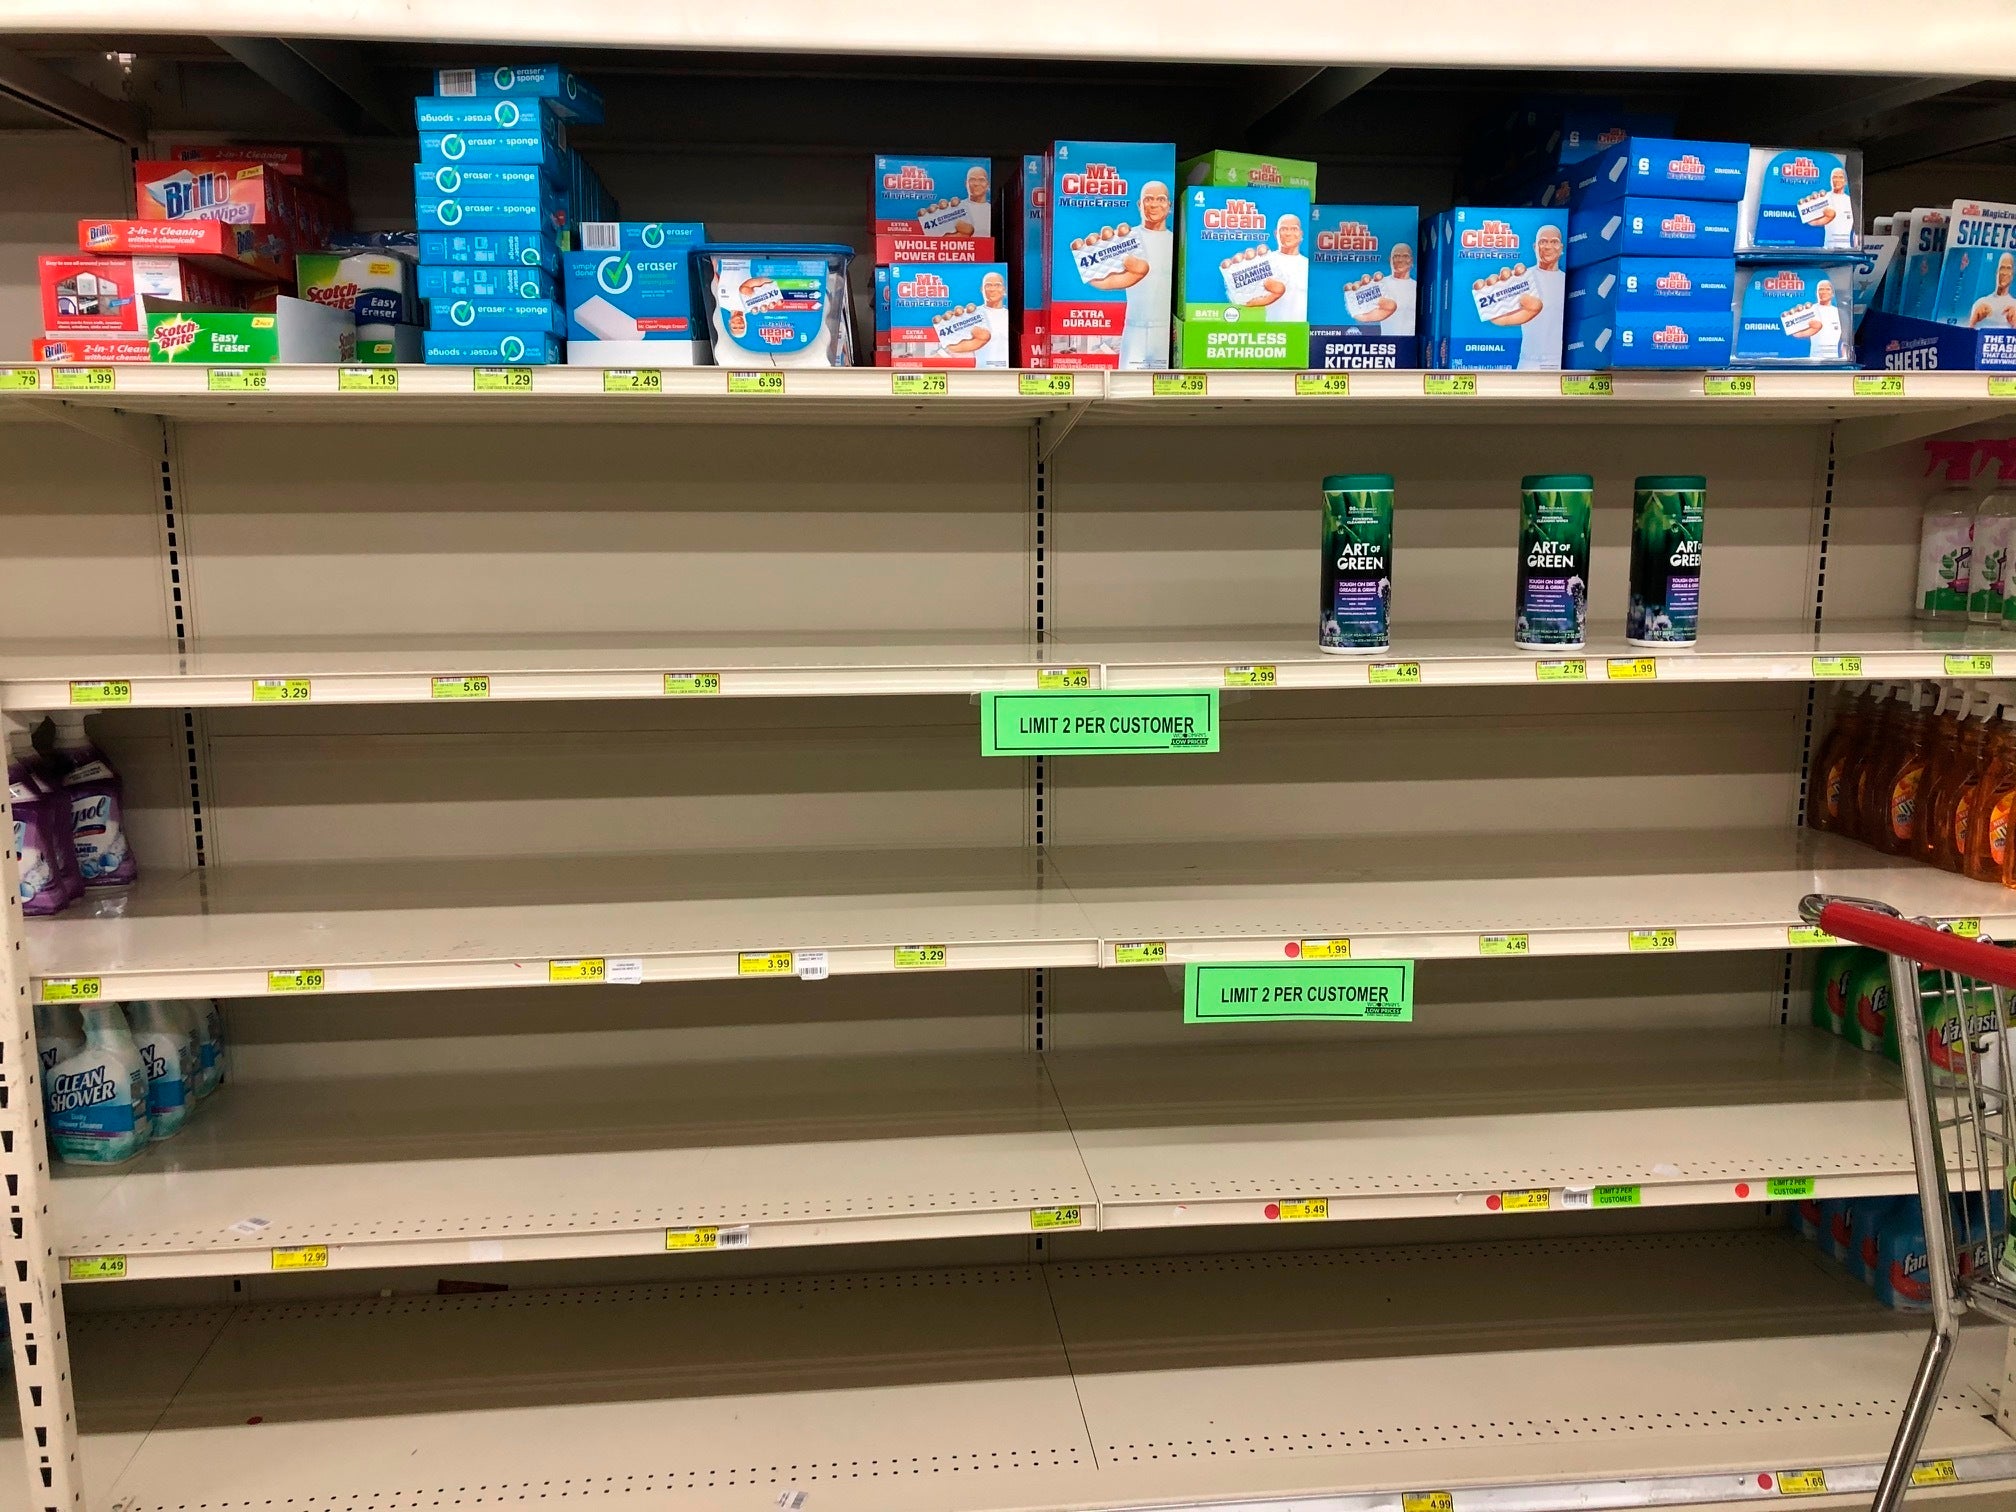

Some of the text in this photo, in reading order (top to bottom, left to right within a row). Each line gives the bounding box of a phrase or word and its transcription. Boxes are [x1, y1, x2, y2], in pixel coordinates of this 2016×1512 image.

[468, 138, 538, 146] eraser sponge
[1639, 158, 1649, 170] 6
[1669, 160, 1705, 174] Clean
[901, 166, 927, 179] Mr.
[1086, 163, 1119, 181] Mr.
[1781, 164, 1820, 178] Clean
[463, 172, 534, 182] eraser sponge
[883, 175, 934, 191] Clean
[1061, 175, 1128, 196] Clean
[163, 172, 230, 218] Brillo
[1194, 191, 1205, 203] 4
[465, 204, 536, 214] eraser sponge
[1226, 200, 1257, 215] Mr.
[1763, 210, 1796, 218] ORIGINAL
[1204, 210, 1266, 230] Clean
[1633, 217, 1643, 230] 6
[1339, 222, 1369, 237] Mr.
[1482, 220, 1512, 235] Mr.
[1661, 219, 1695, 233] Clean
[128, 227, 205, 238] 2-in-1 Cleaning
[894, 240, 975, 250] WHOLE HOME
[1317, 232, 1378, 252] Clean
[1461, 230, 1519, 250] Clean
[894, 252, 975, 262] POWER CLEAN
[1079, 251, 1100, 268] 4X
[637, 262, 678, 271] eraser
[916, 274, 942, 287] Mr.
[1627, 277, 1638, 288] 6
[1656, 277, 1691, 290] Clean
[1763, 279, 1805, 291] Clean
[897, 282, 949, 298] Clean
[1355, 288, 1381, 301] POWER
[371, 298, 396, 308] Easy
[1479, 293, 1497, 308] 2X
[362, 308, 397, 318] Eraser
[516, 306, 548, 314] sponge
[1070, 310, 1104, 318] EXTRA
[1062, 318, 1111, 328] DURABLE
[160, 334, 193, 349] Brite
[211, 333, 238, 343] Easy
[1207, 333, 1287, 344] SPOTLESS
[1622, 331, 1633, 343] 6
[1653, 331, 1688, 344] Clean
[1984, 335, 2004, 343] THE
[213, 343, 250, 352] Eraser
[1207, 346, 1287, 358] BATHROOM
[1325, 344, 1396, 355] SPOTLESS
[1465, 344, 1505, 352] ORIGINAL
[1325, 357, 1396, 368] KITCHEN
[1886, 347, 1938, 370] SHEETS
[87, 374, 112, 383] 1.99
[368, 375, 395, 384] 1.19
[504, 375, 530, 385] 1.29
[632, 376, 659, 386] 2.49
[758, 378, 782, 387] 6.99
[923, 381, 945, 390] 2.79
[1049, 381, 1070, 390] 4.99
[1324, 381, 1346, 389] 4.99
[1453, 381, 1474, 389] 2.79
[1589, 382, 1610, 390] 4.99
[1731, 381, 1752, 390] 6.99
[1881, 381, 1901, 390] 2.79
[1342, 543, 1381, 556] ART OF
[1532, 541, 1558, 554] ART
[1675, 541, 1698, 553] ART
[1337, 557, 1383, 570] GREEN
[1527, 555, 1574, 568] GREEN
[1562, 664, 1584, 675] 2.79
[1633, 664, 1653, 673] 1.99
[1840, 662, 1860, 671] 1.59
[1971, 661, 1991, 670] 1.59
[1397, 667, 1418, 676] 4.49
[1063, 677, 1087, 687] 5.49
[1250, 672, 1274, 682] 2.99
[463, 682, 487, 691] 5.69
[694, 679, 717, 688] 9.99
[103, 686, 128, 695] 8.99
[281, 688, 308, 698] 3.29
[1020, 717, 1194, 734] LIMIT 2 PER CUSTOMER
[72, 796, 106, 826] ysol
[1958, 922, 1977, 930] 2.79
[1507, 941, 1526, 950] 4.49
[1652, 937, 1674, 946] 3.29
[1143, 947, 1164, 956] 4.49
[1327, 945, 1347, 953] 1.99
[920, 950, 944, 960] 3.29
[768, 959, 789, 968] 3.99
[581, 966, 603, 975] 3.99
[295, 976, 322, 985] 5.69
[71, 983, 98, 994] 5.69
[1221, 986, 1388, 1003] LIMIT 2 PER CUSTOMER
[55, 1066, 105, 1096] CLEAN
[50, 1080, 116, 1113] SHOWER
[1794, 1178, 1806, 1186] PER
[1774, 1187, 1806, 1195] CUSTOMER
[1528, 1193, 1547, 1203] 2.99
[1600, 1194, 1633, 1203] CUSTOMER
[1055, 1209, 1079, 1220] 2.49
[1305, 1205, 1325, 1214] 5.49
[694, 1233, 716, 1243] 3.99
[303, 1252, 326, 1262] 12.99
[100, 1262, 123, 1271] 4.49
[1936, 1467, 1954, 1476] 1.69
[1804, 1477, 1824, 1487] 1.69
[1431, 1500, 1451, 1509] 4.99
